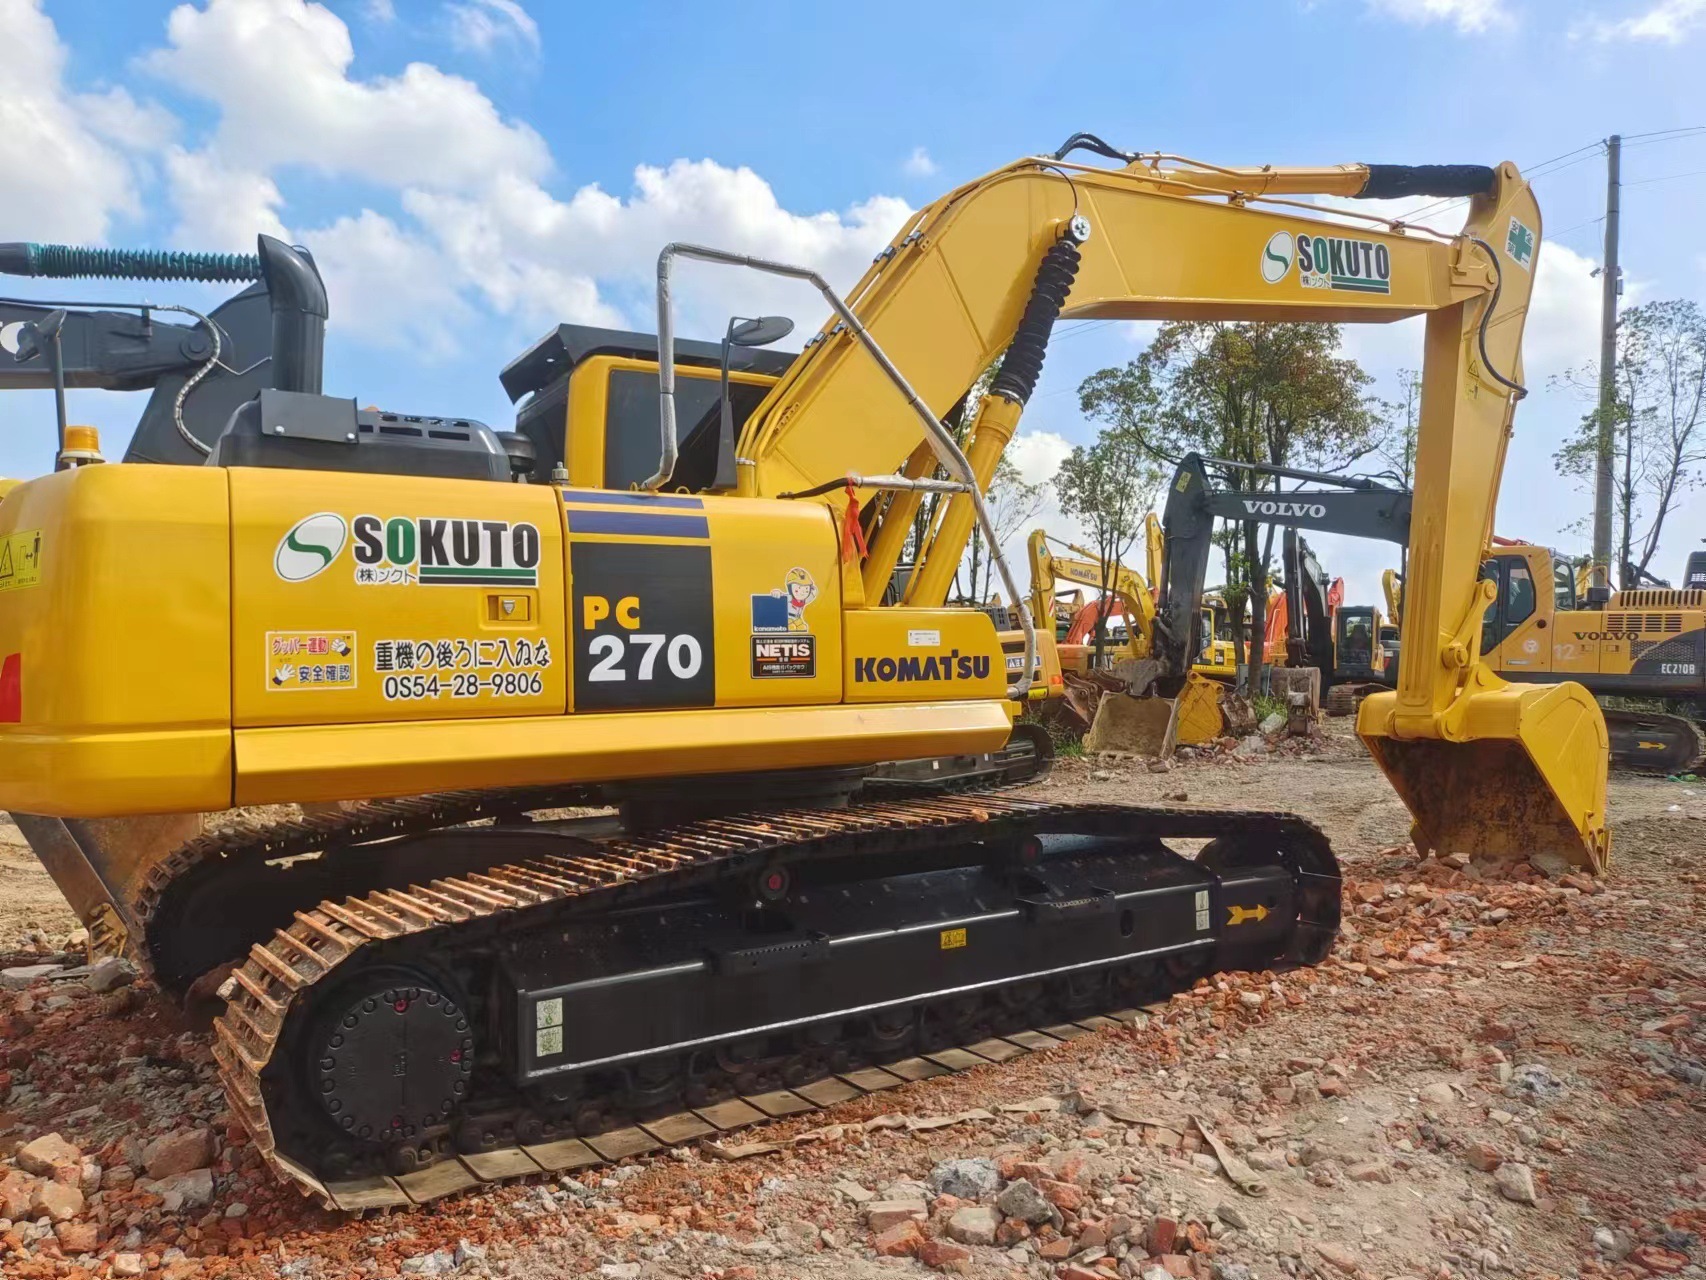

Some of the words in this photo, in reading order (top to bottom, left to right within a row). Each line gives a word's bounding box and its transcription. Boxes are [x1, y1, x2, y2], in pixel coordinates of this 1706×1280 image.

[1297, 234, 1390, 280] SOKUTO
[1243, 499, 1327, 518] VOLVO
[353, 516, 539, 568] SOKUTO
[1573, 631, 1639, 641] VOLVO
[588, 634, 702, 682] 270
[755, 643, 811, 657] NETIS
[854, 649, 990, 682] KOMATSU
[1661, 663, 1696, 674] EC210B
